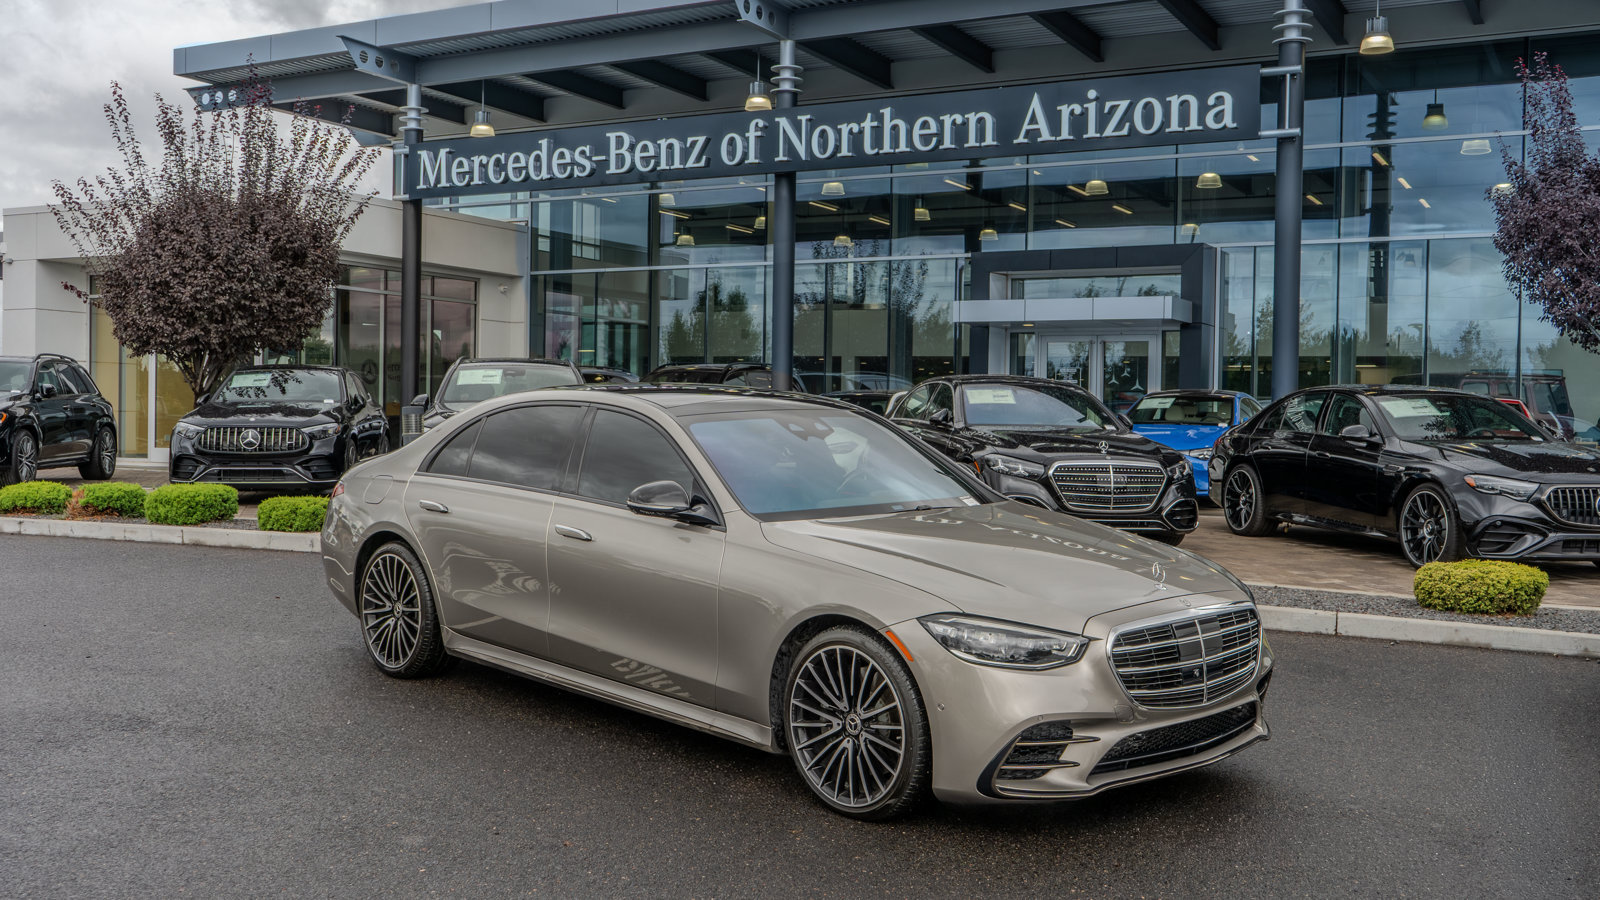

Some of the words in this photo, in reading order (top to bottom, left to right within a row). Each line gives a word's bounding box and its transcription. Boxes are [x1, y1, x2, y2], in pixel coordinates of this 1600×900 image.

[417, 132, 708, 190] Mercedes-Benz
[720, 118, 768, 166] of
[774, 108, 999, 162] Northern
[1013, 89, 1238, 144] Arizona
